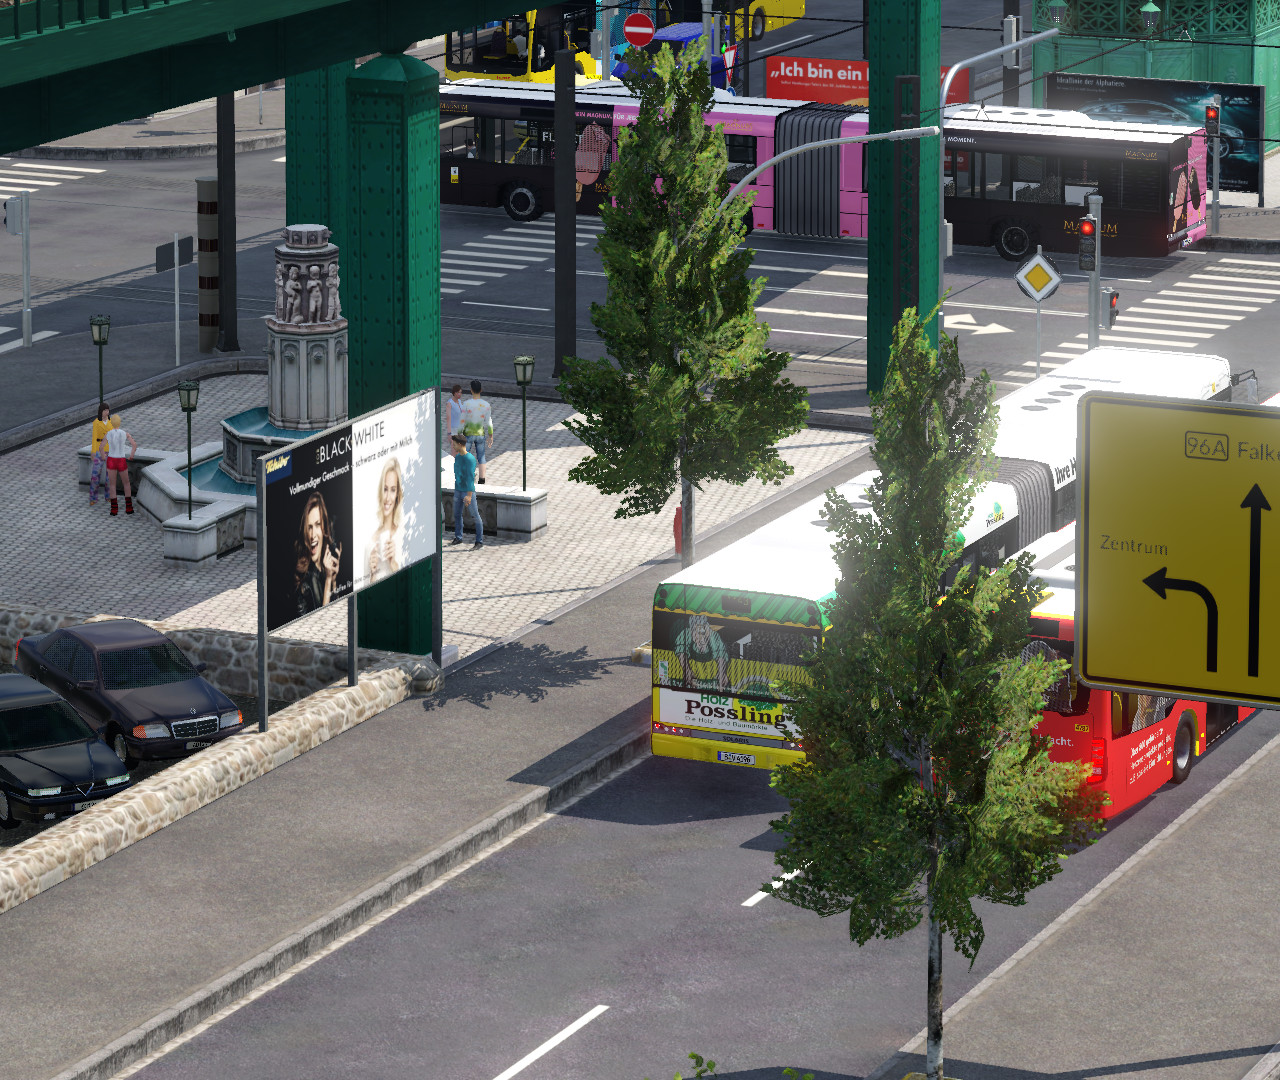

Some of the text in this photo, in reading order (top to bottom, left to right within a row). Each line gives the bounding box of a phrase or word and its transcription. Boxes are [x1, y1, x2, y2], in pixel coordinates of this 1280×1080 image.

[807, 62, 833, 79] bin
[837, 65, 862, 81] ein
[613, 112, 625, 120] FÜR
[1063, 220, 1119, 235] MAUM
[319, 421, 385, 463] BLACK WHITE
[1186, 435, 1227, 457] 96A
[265, 454, 291, 474] Tchibo
[289, 436, 413, 496] Vollmundiger Geschmack schwarz oder mit Milch
[1100, 534, 1169, 557] Zentrum
[685, 699, 788, 729] Possling
[723, 735, 750, 744] SOLARIS
